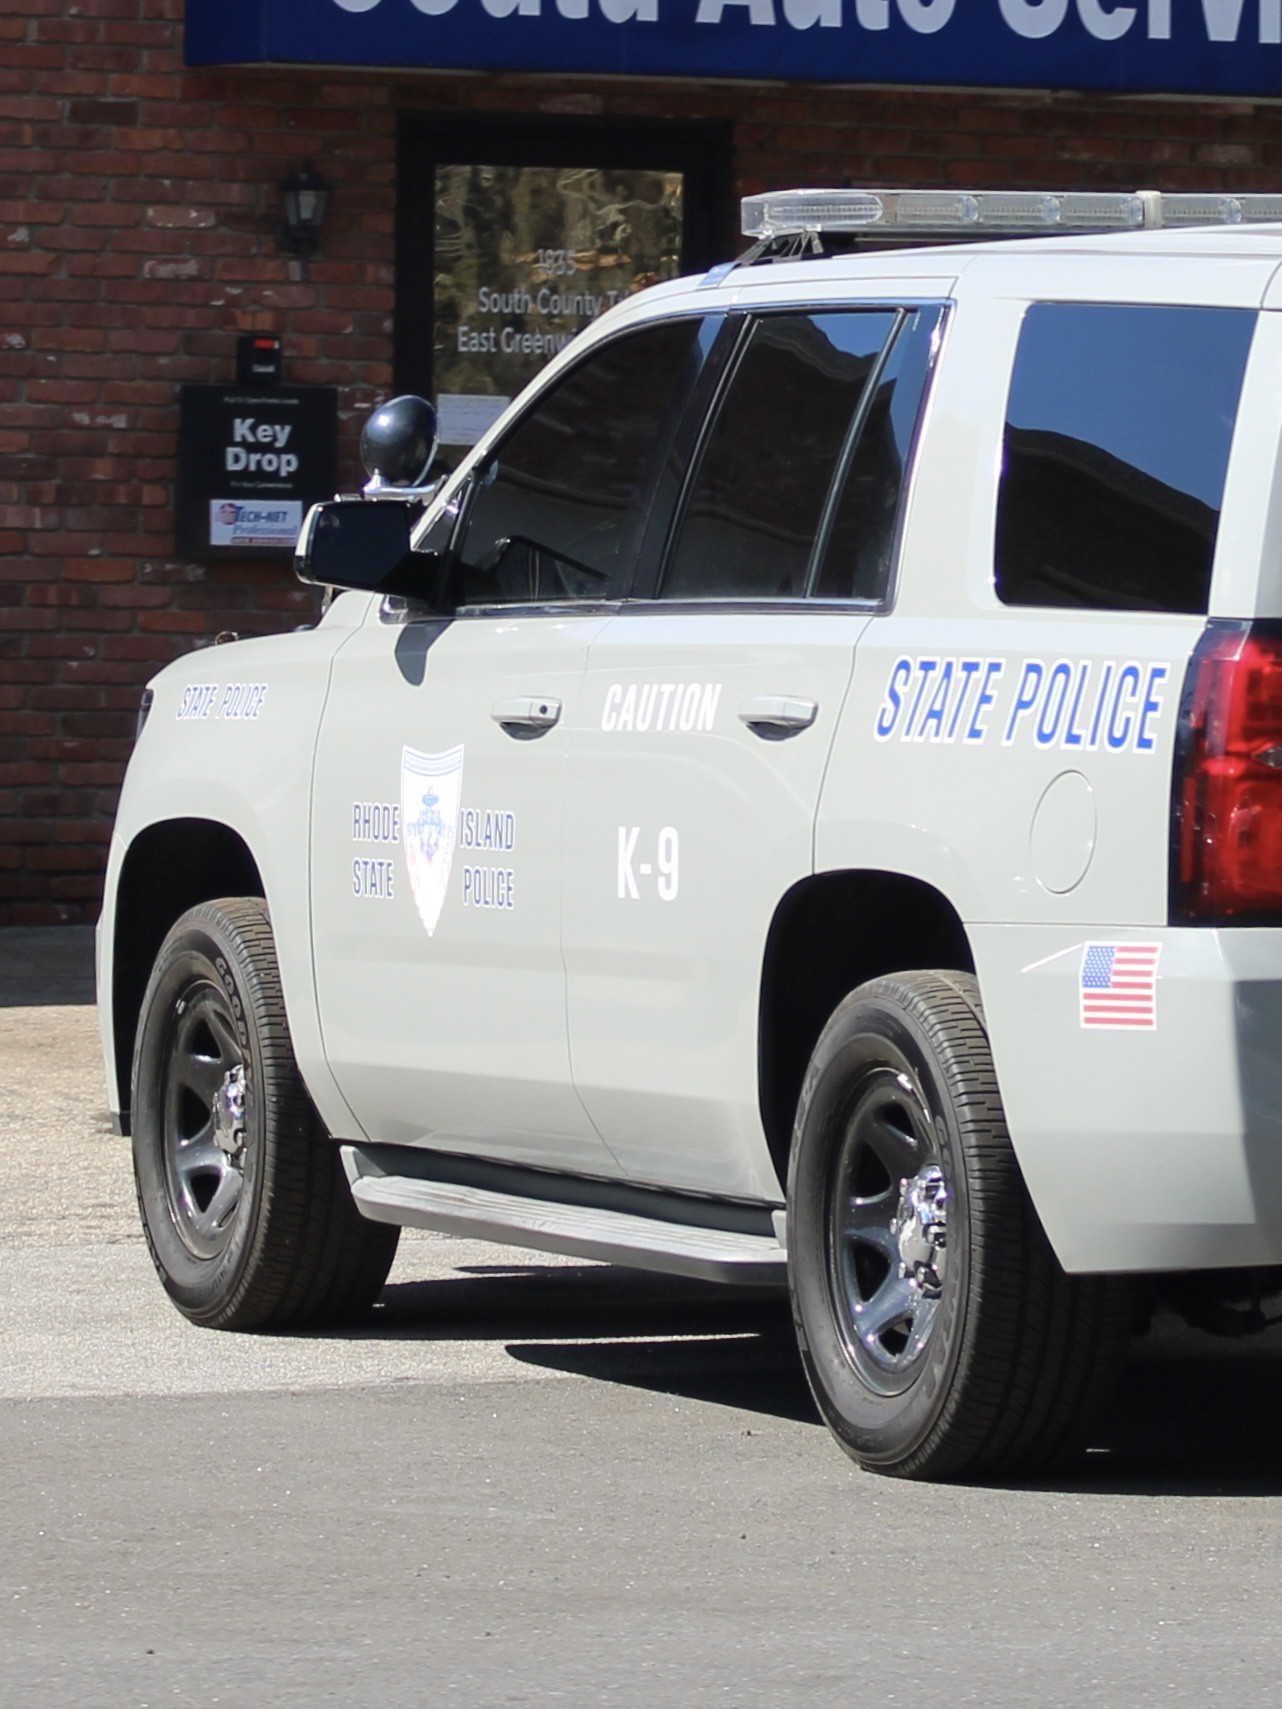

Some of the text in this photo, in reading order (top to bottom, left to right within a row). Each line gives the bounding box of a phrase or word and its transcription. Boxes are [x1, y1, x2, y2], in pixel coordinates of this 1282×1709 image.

[537, 249, 577, 275] 1935
[478, 286, 533, 314] South
[537, 288, 602, 318] County
[458, 326, 497, 353] East
[233, 418, 292, 448] Key
[225, 447, 299, 476] Drop
[176, 682, 269, 721] STATE POLICE
[601, 682, 722, 732] CAUTION
[873, 655, 1171, 754] STATE POLICE
[352, 801, 401, 844] RHODE
[458, 807, 515, 852] ISLAND
[352, 857, 394, 899] STATE
[617, 826, 679, 901] K-9
[462, 866, 515, 910] POLICE
